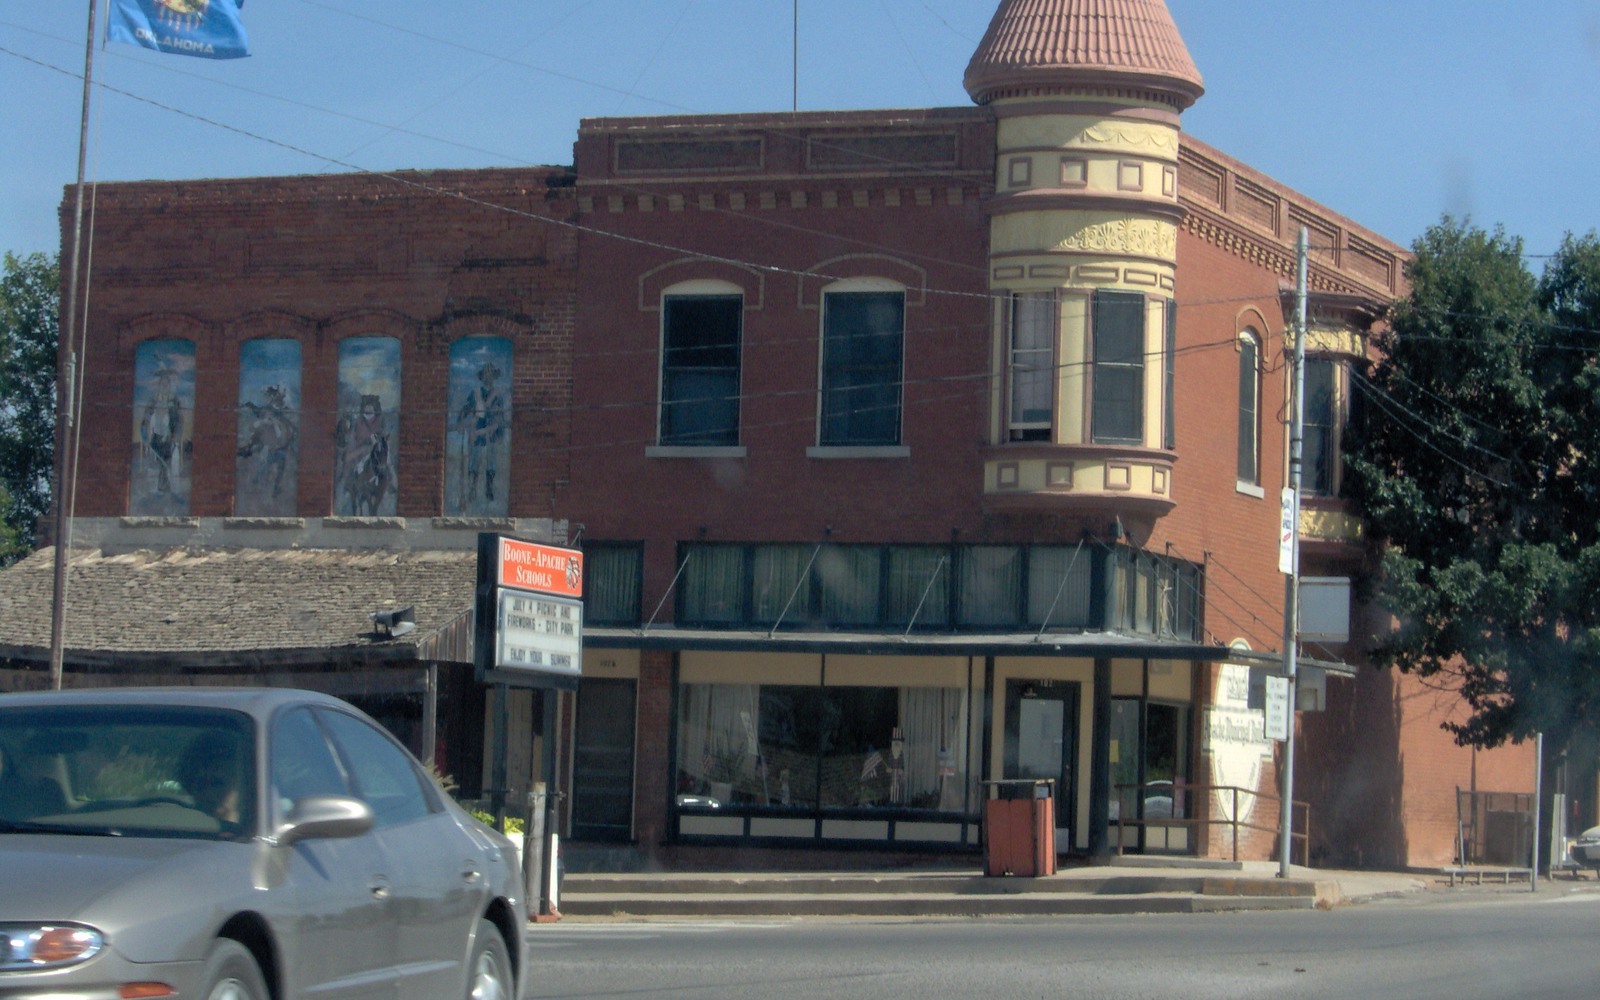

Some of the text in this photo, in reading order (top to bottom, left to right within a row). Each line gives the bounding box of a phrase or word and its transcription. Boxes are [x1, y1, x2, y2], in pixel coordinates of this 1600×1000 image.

[135, 27, 215, 54] OKLAHOMA
[516, 565, 552, 587] SCHOOLS
[537, 602, 557, 617] PICNIC
[507, 613, 536, 631] FIREWORKS
[546, 620, 558, 633] CITY
[561, 622, 573, 636] PARK
